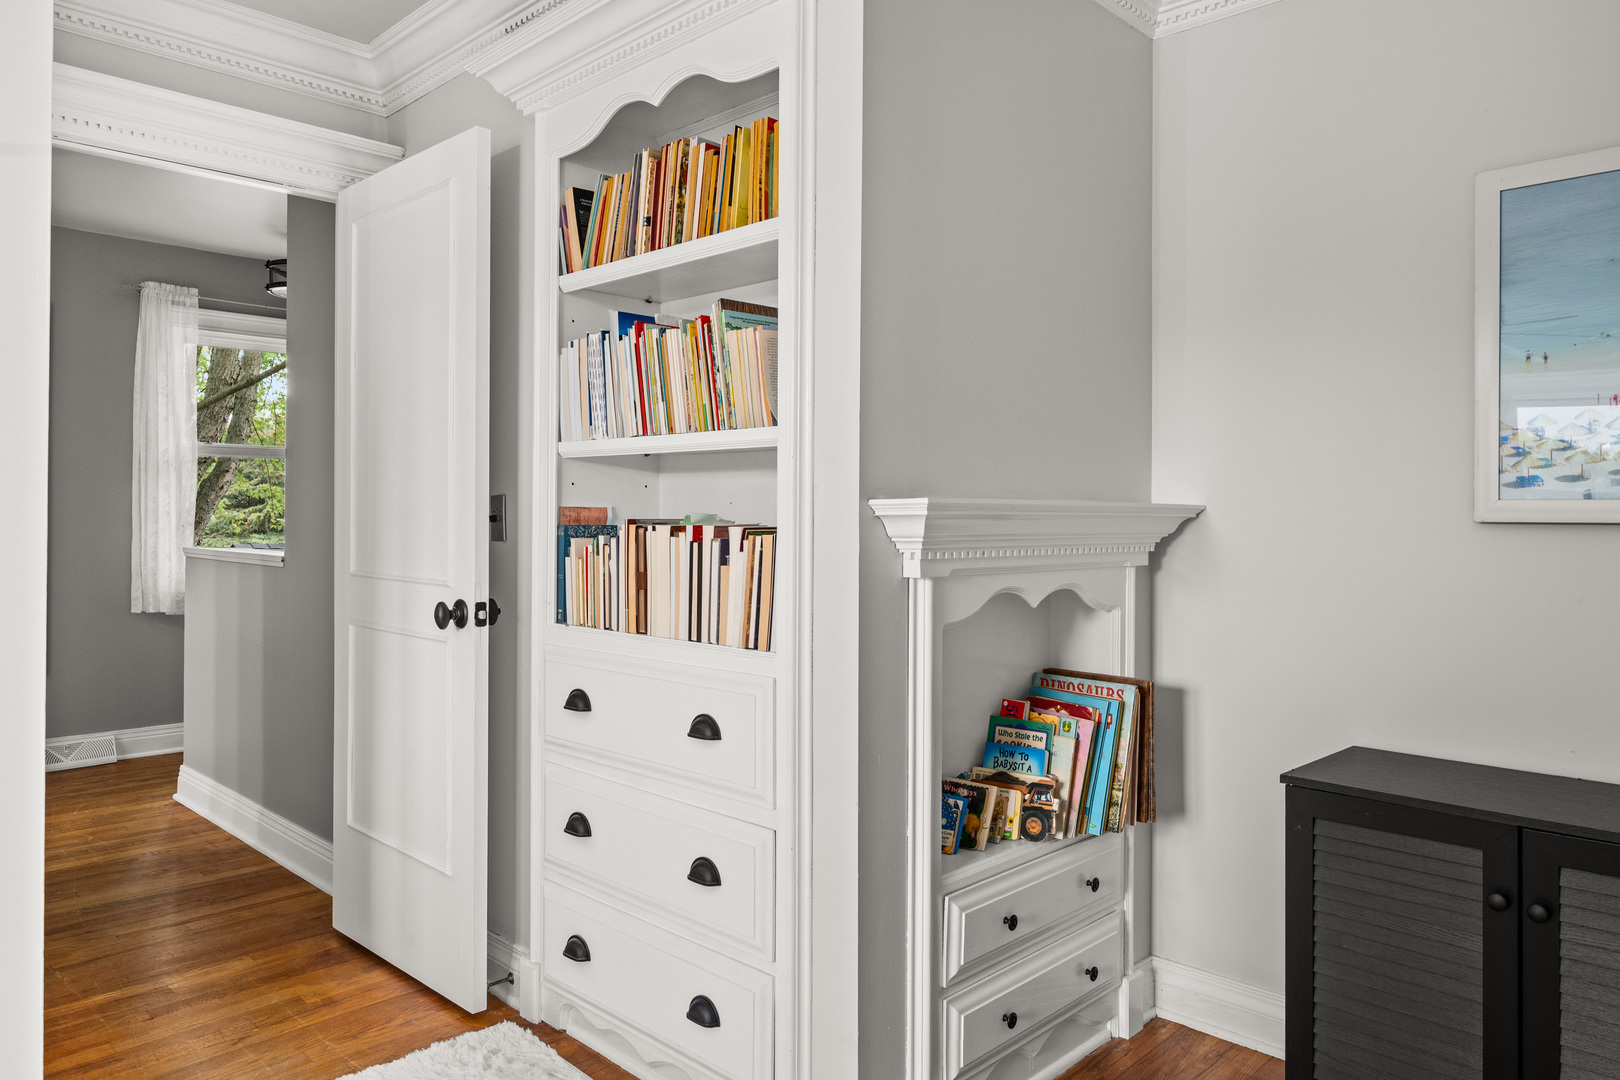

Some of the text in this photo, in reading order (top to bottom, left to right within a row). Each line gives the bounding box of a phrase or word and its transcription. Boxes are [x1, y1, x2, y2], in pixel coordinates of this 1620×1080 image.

[1040, 677, 1125, 700] DINOSAURS
[998, 729, 1013, 738] Who
[1015, 731, 1031, 740] Stole
[999, 747, 1029, 761] HOW TO
[993, 756, 1032, 773] BABYSIT A
[943, 784, 960, 793] Who
